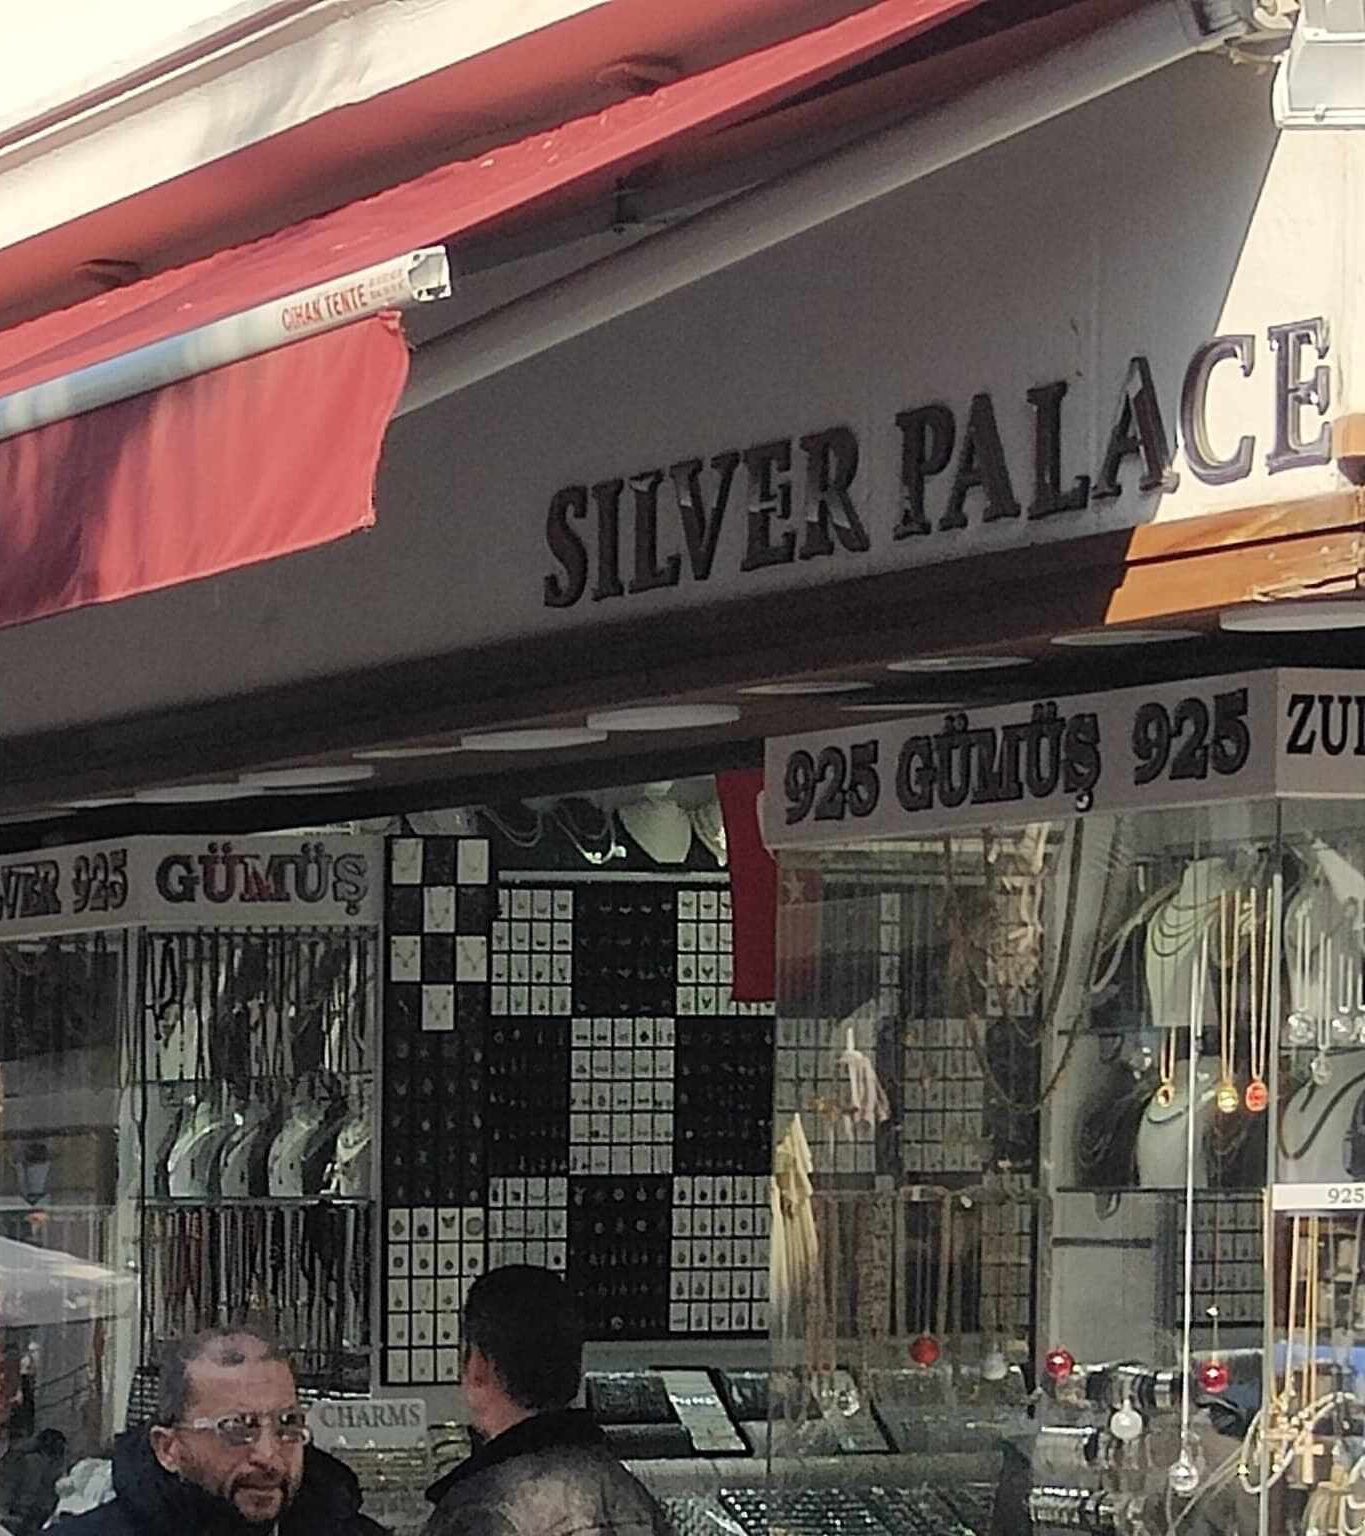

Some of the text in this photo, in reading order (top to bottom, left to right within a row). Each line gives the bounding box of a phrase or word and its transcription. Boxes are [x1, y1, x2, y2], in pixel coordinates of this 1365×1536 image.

[544, 316, 1333, 608] SILVER PALACE
[784, 688, 1251, 826] 925 GÜMÜŞ 925
[72, 848, 129, 914] 925
[156, 841, 368, 916] GÜMÜŞ
[1328, 1187, 1365, 1204] 925
[322, 1404, 421, 1430] CHARMS
